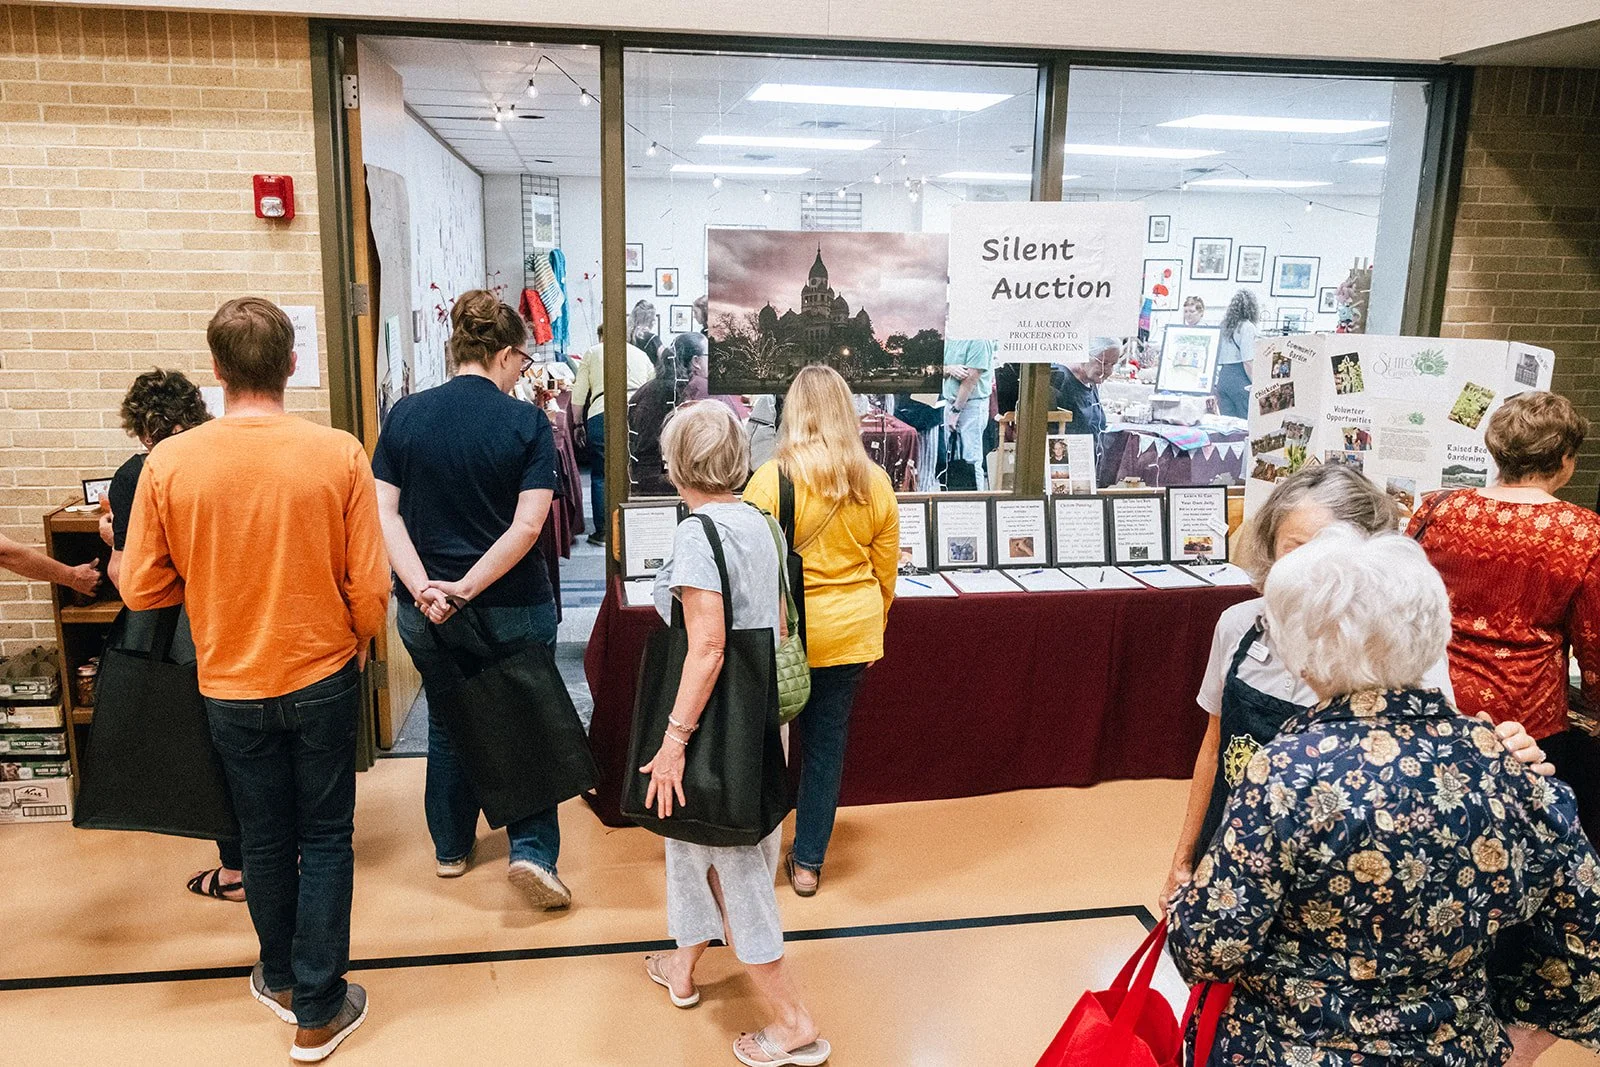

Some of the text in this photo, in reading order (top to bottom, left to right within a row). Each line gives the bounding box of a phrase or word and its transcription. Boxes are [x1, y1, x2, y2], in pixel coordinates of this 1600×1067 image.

[982, 236, 1075, 261] Silent
[991, 274, 1111, 300] Auction
[1017, 320, 1072, 328] ALL AUCTION
[1003, 343, 1084, 351] SHILOH GARDENS
[1286, 340, 1317, 358] Community
[1254, 382, 1280, 400] Chickens
[1334, 405, 1365, 414] Volunteer
[1326, 412, 1372, 424] Opportunities
[1447, 444, 1472, 454] Raised
[1447, 452, 1486, 463] Gardening
